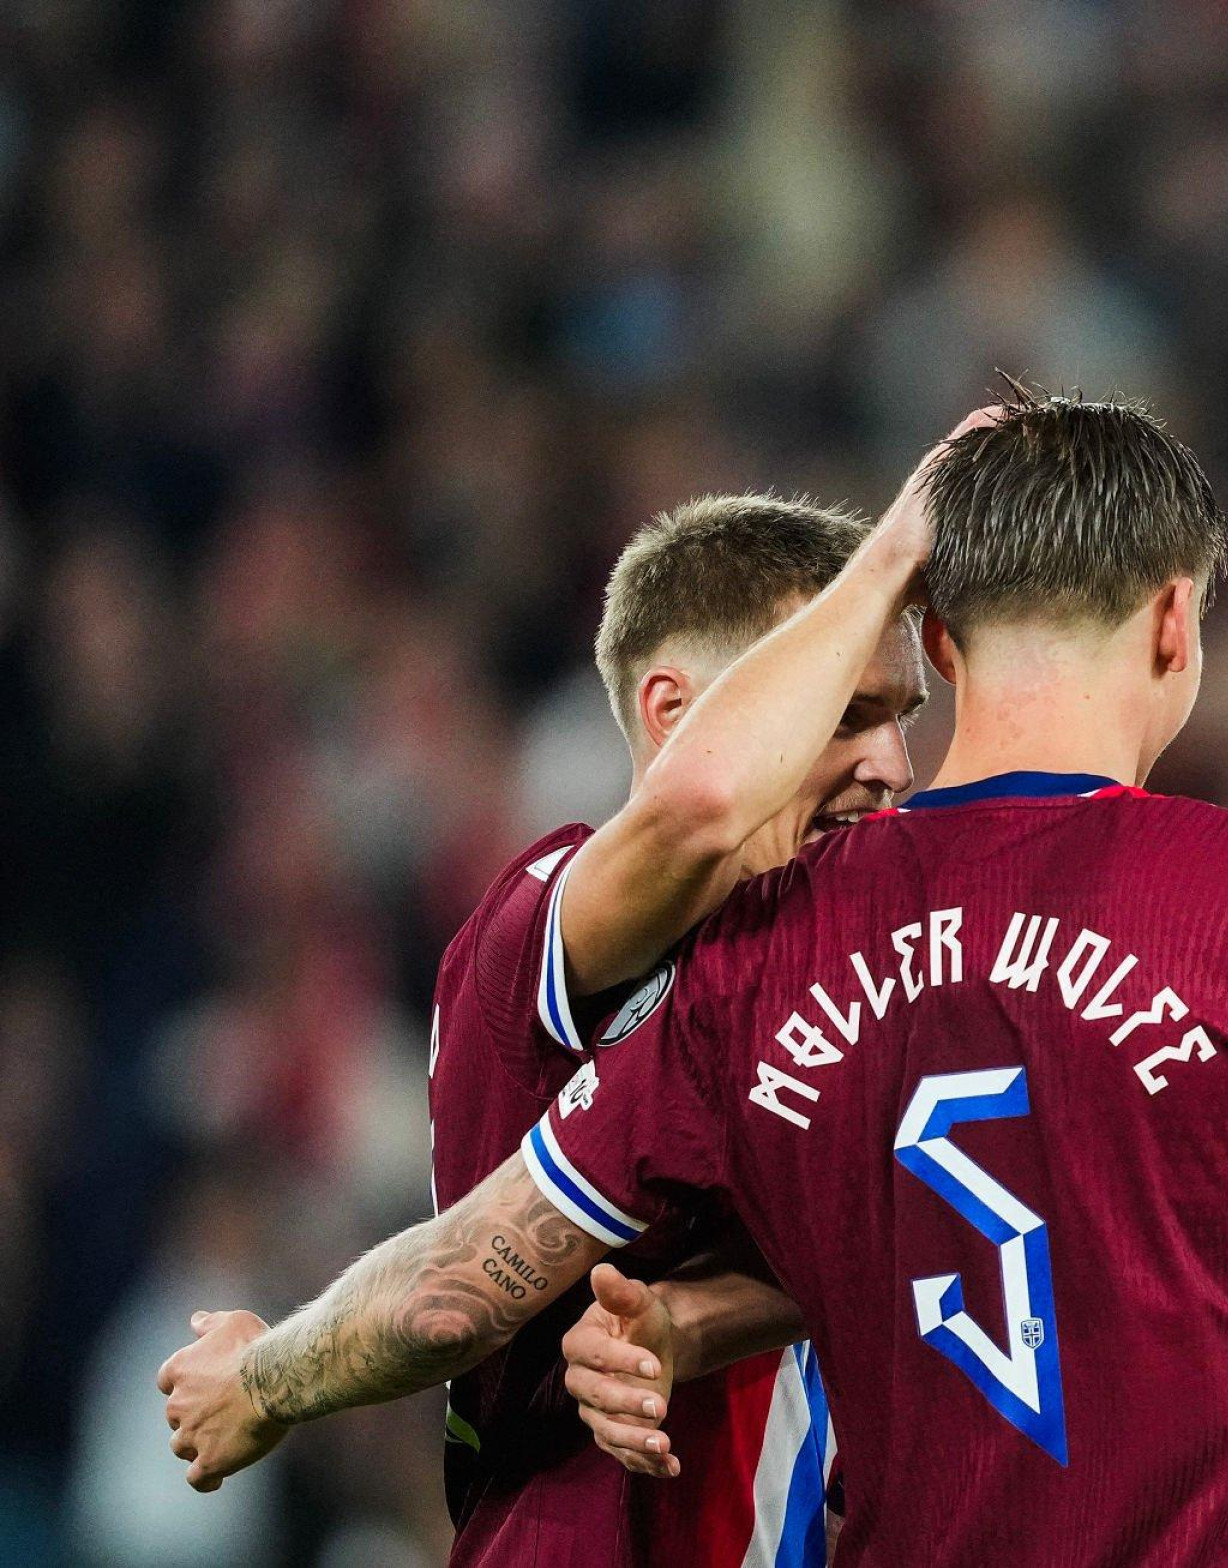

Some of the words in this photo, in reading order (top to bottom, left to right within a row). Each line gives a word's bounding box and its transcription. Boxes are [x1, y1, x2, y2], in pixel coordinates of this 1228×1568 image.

[748, 907, 964, 1130] MØLLER
[989, 912, 1217, 1096] WOLFE
[482, 1258, 526, 1300] CANO
[491, 1235, 548, 1291] CAMILO
[893, 1065, 1069, 1468] 5
